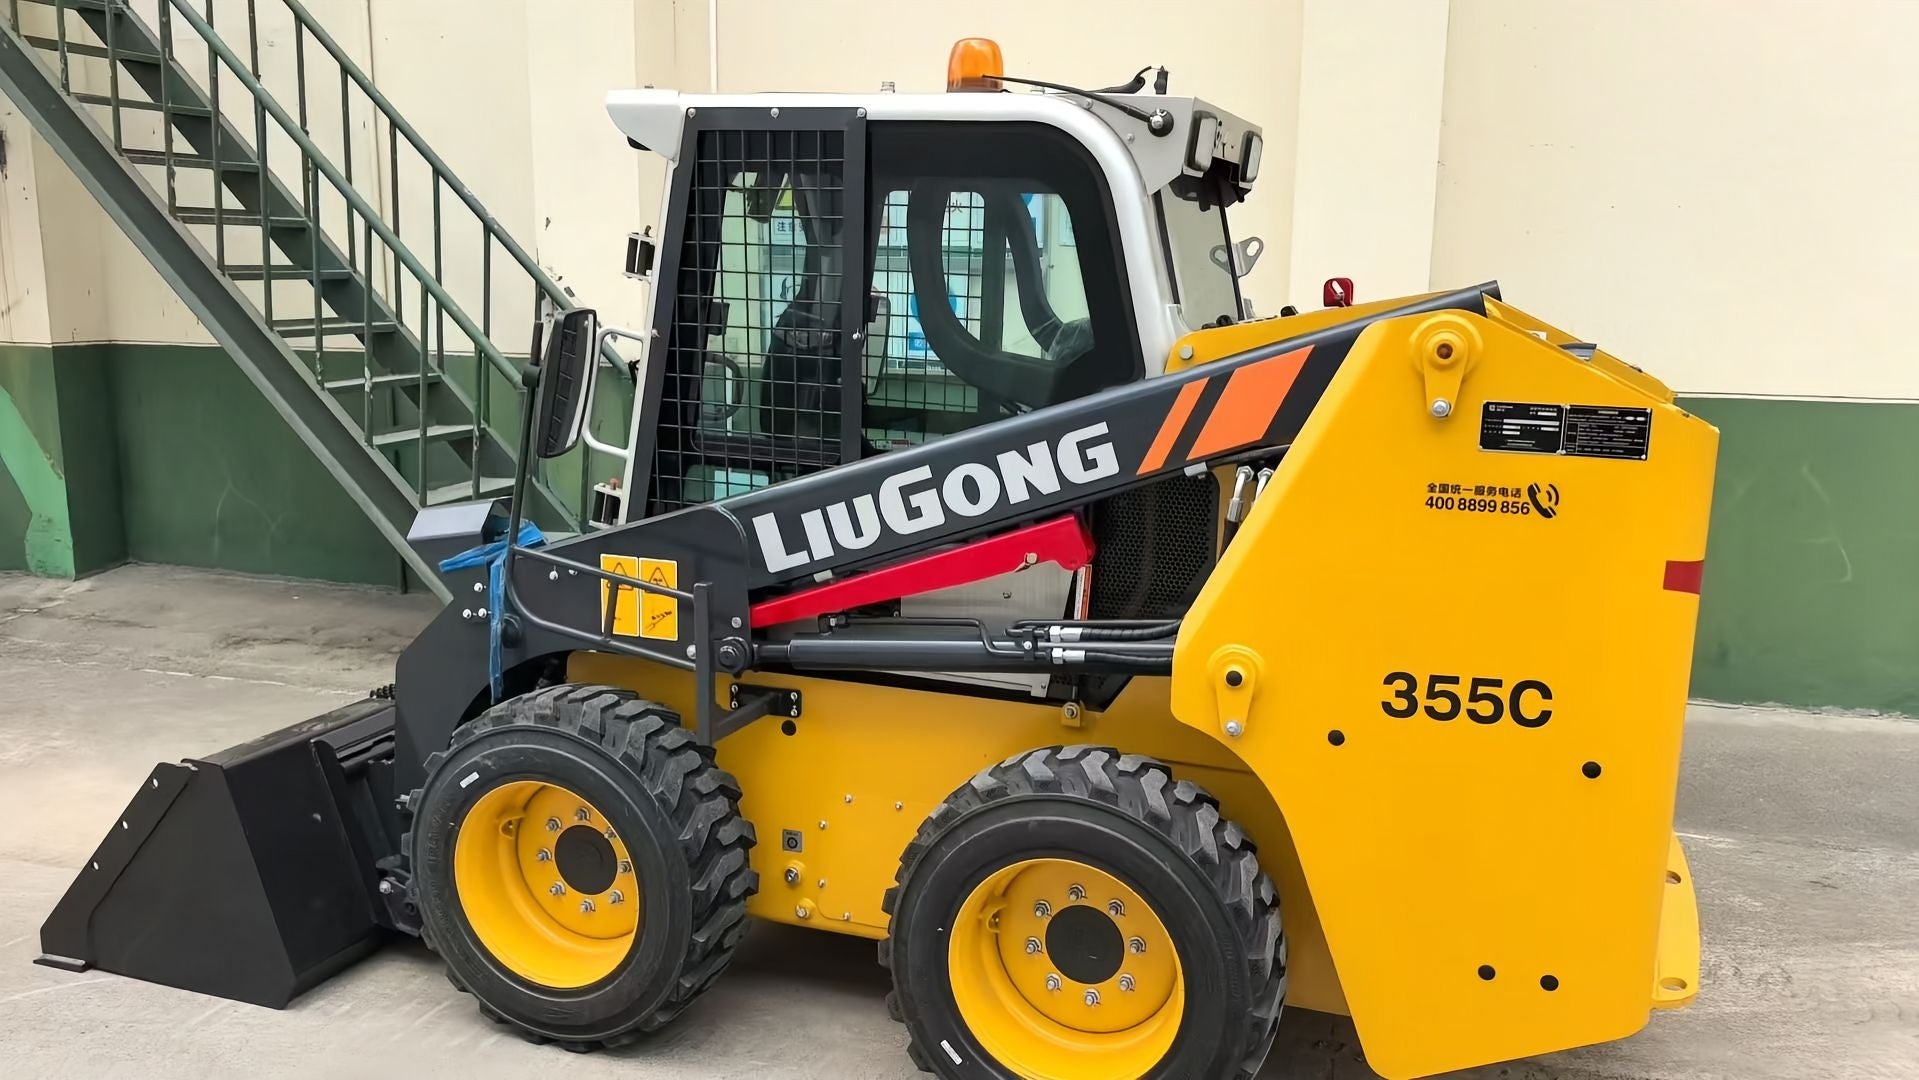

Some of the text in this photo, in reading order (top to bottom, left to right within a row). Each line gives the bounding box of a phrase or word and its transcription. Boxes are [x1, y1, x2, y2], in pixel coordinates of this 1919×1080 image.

[752, 421, 1120, 573] LIUGONG
[1425, 496, 1530, 515] 400 8899 856
[1427, 483, 1522, 498] 全国统一服务电话
[1381, 671, 1553, 728] 355C
